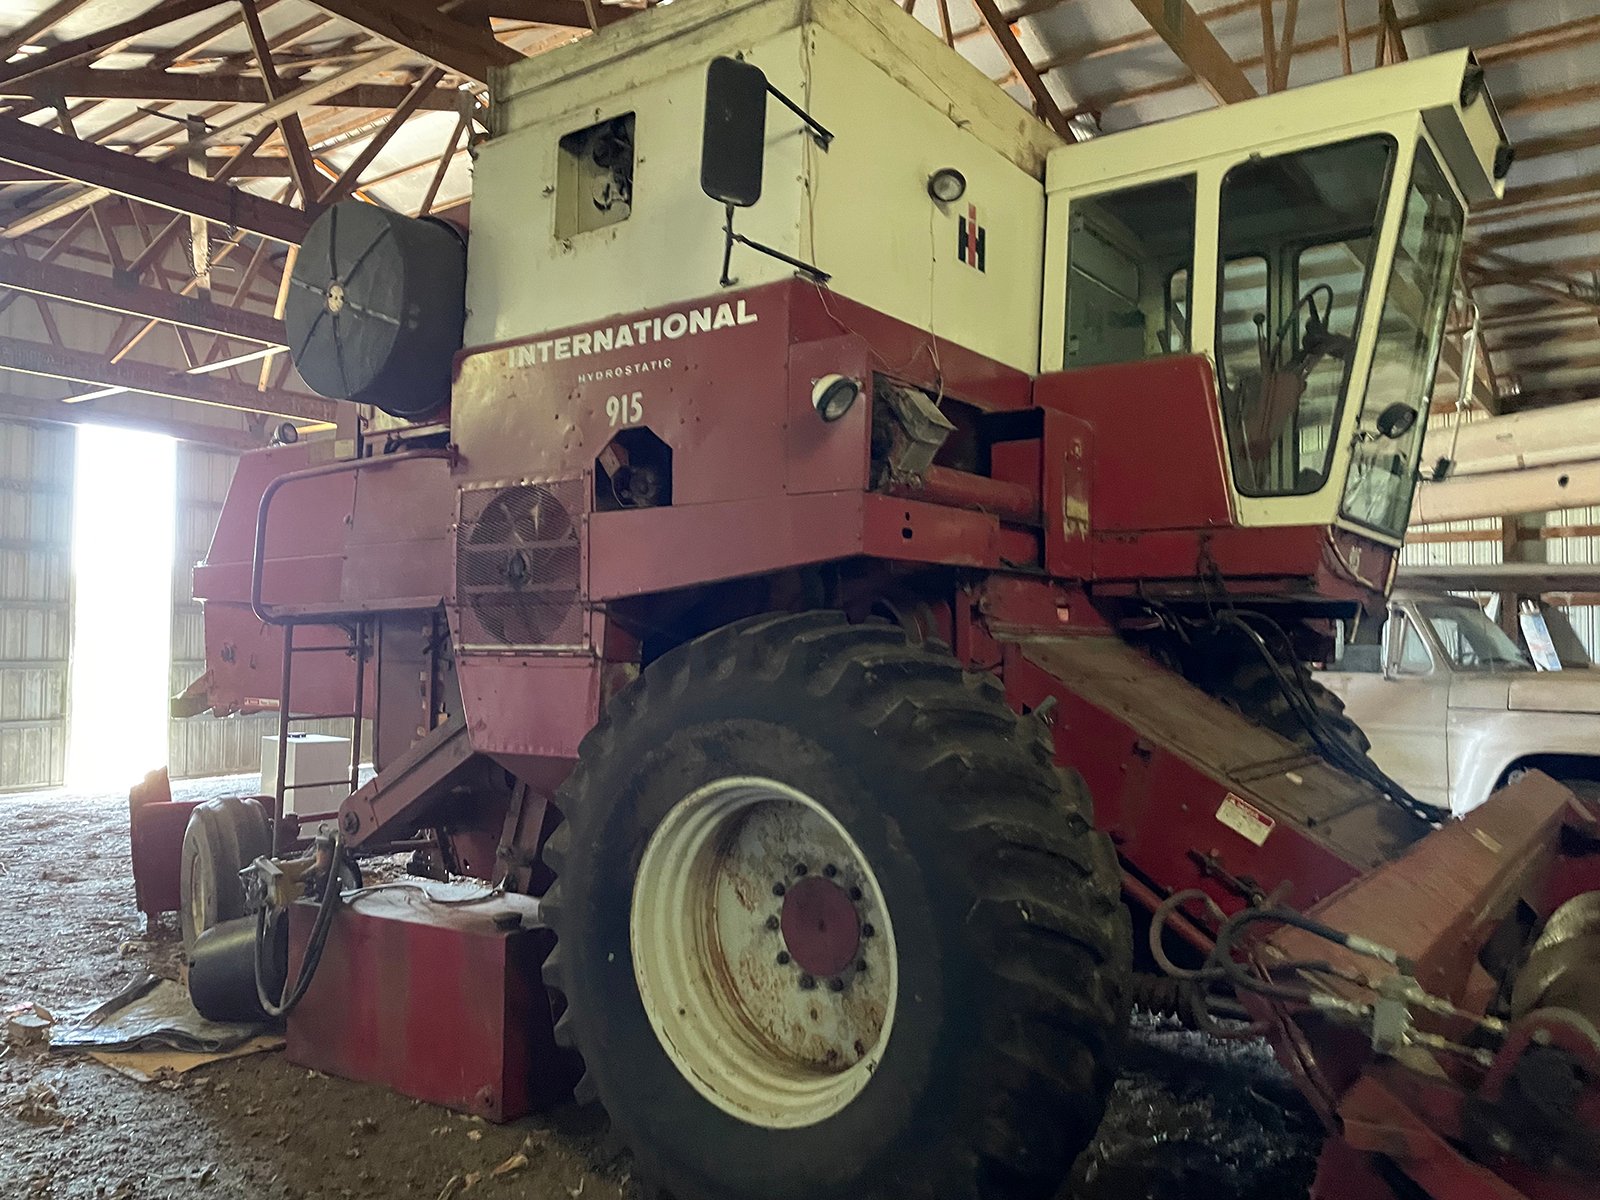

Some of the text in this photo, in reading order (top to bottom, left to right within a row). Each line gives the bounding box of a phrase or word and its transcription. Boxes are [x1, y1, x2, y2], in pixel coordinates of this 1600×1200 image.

[508, 299, 758, 369] INTERNATIONAL
[578, 357, 673, 384] HYDROSTATIC
[606, 391, 644, 427] 915
